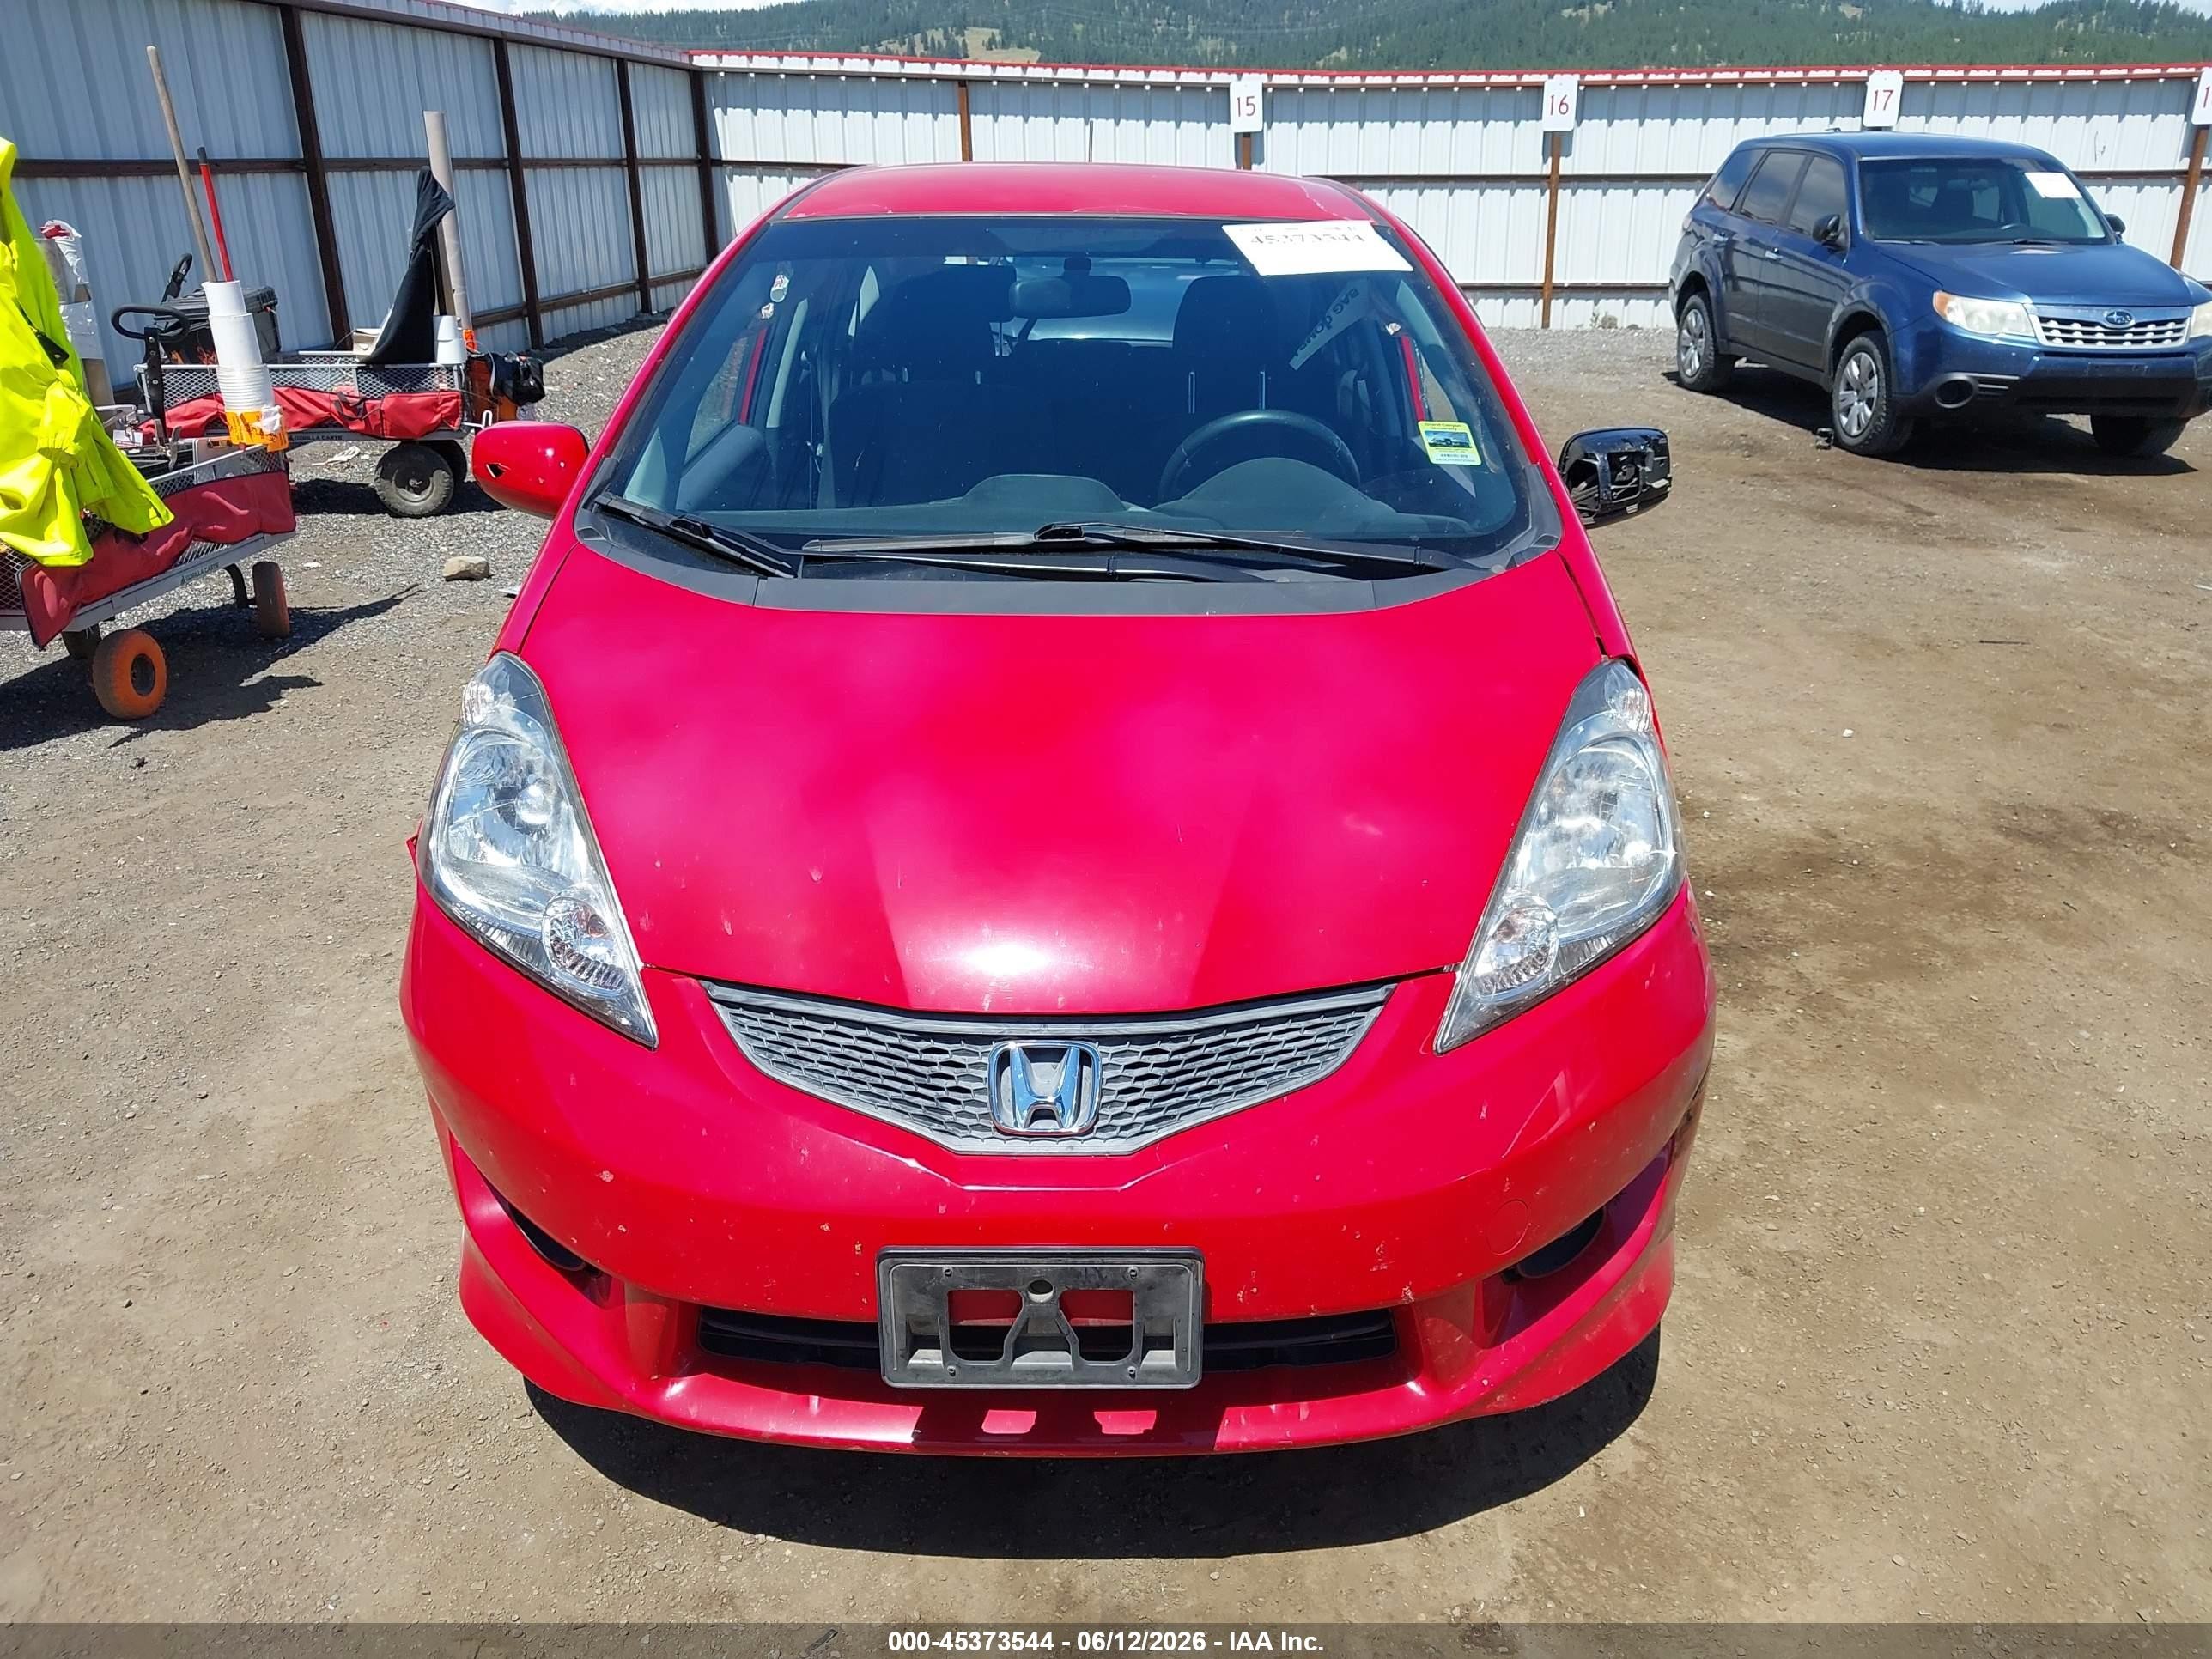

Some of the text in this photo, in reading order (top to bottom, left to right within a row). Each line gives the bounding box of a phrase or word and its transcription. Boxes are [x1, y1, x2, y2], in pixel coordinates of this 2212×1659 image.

[1237, 95, 1255, 117] 15
[1549, 94, 1569, 115] 16
[1873, 88, 1895, 111] 17
